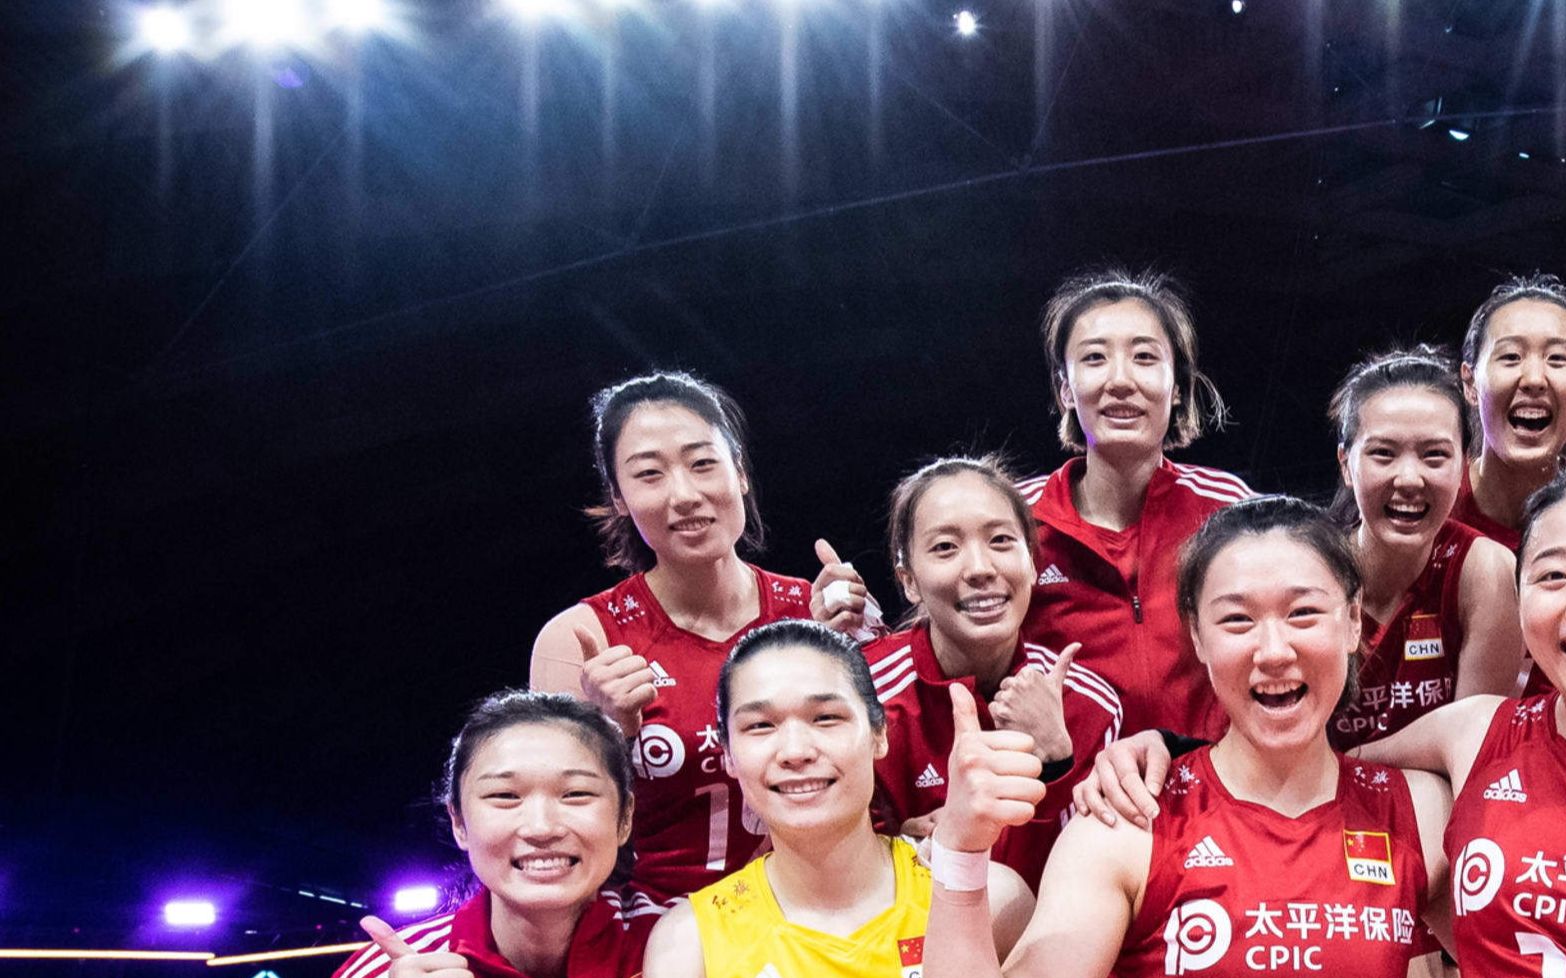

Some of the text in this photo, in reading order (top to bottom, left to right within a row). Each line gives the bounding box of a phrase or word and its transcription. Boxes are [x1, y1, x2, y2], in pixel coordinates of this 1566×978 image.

[1408, 643, 1440, 656] CHN
[1482, 788, 1528, 804] adidas
[1184, 855, 1235, 869] adidas
[1353, 863, 1389, 879] CHN
[1244, 902, 1416, 945] 太平洋保险
[1244, 945, 1323, 971] CPIC
